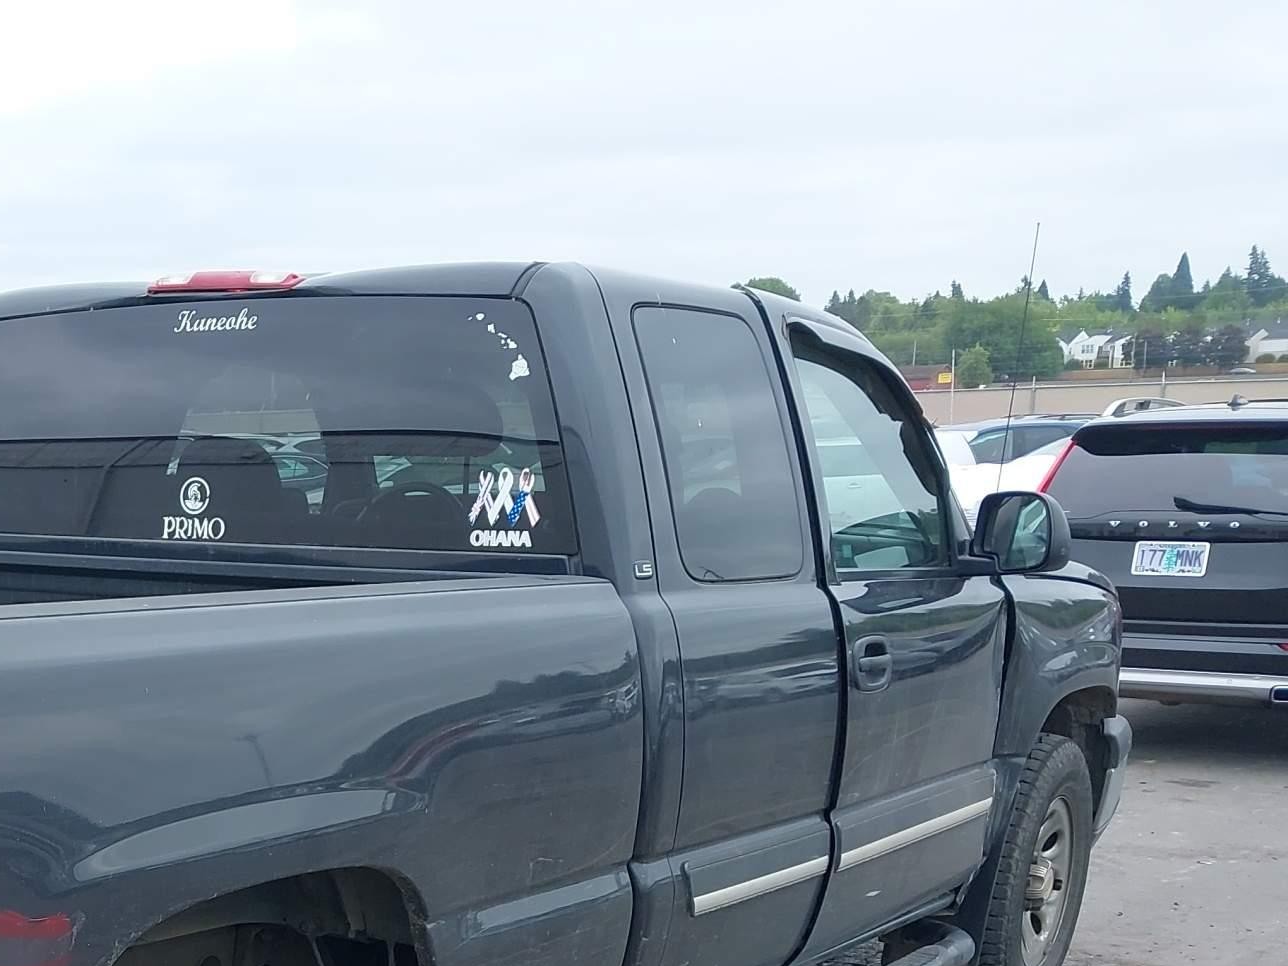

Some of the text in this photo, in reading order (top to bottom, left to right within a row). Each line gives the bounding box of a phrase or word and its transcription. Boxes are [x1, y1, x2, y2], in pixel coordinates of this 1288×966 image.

[162, 516, 225, 540] PRIMO
[1109, 520, 1240, 528] VOLVO
[470, 530, 532, 547] OHANA
[1175, 549, 1204, 567] MNK
[634, 564, 653, 576] LS
